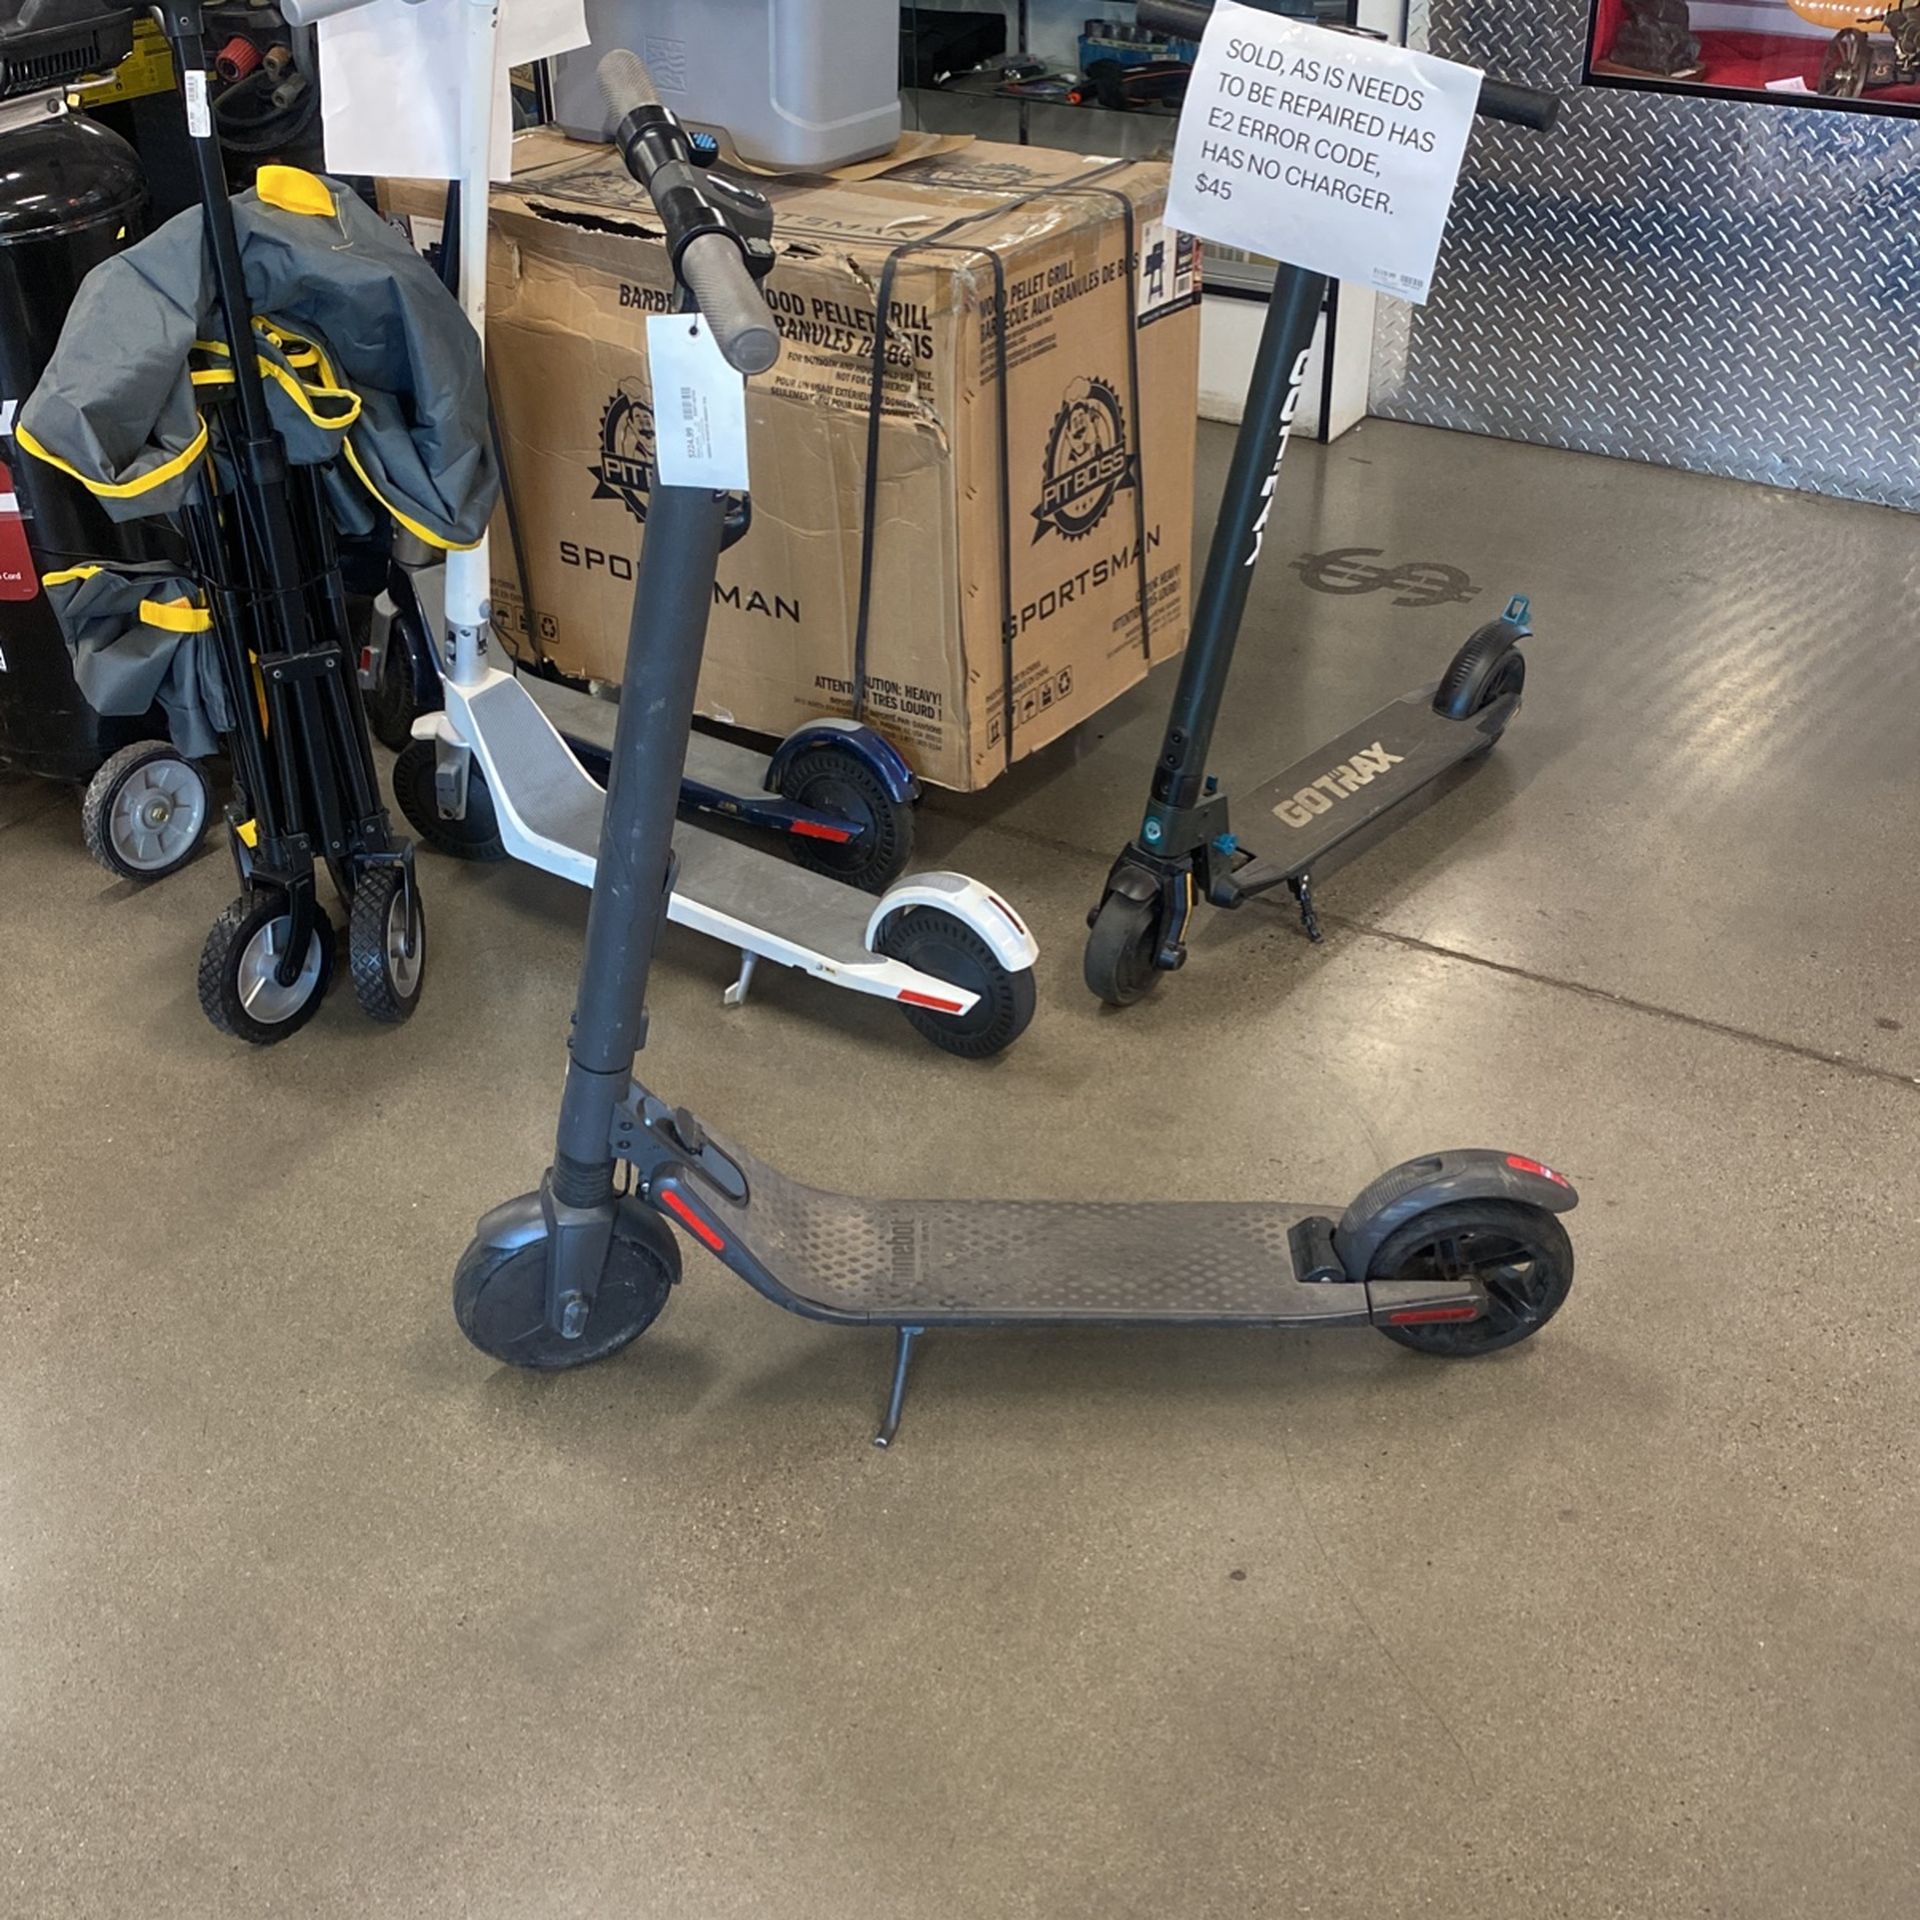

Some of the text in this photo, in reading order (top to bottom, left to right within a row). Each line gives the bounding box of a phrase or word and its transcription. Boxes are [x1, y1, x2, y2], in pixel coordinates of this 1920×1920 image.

[1226, 38, 1425, 111] SOLD, AS IS NEEDS
[1208, 107, 1381, 177] E2 ERROR CODE,
[1218, 73, 1436, 152] TO BE REPAIRED HAS
[1195, 172, 1233, 200] $45
[1201, 140, 1394, 215] HAS NO CHARGER.
[980, 301, 1029, 344] BARECUE
[1031, 292, 1051, 319] AUX
[1052, 269, 1099, 308] GRANULES
[1102, 261, 1115, 284] DE
[1010, 271, 1045, 305] PELLET
[1048, 259, 1074, 287] GRILL
[619, 283, 673, 314] BARBE
[773, 315, 855, 354] RANULES
[811, 297, 876, 333] PELLET
[890, 301, 933, 331] RILL
[604, 457, 643, 486] PIT
[1044, 451, 1125, 511] PIT BOSS
[900, 700, 936, 719] LOURD
[904, 685, 943, 706] HEAVY!
[1271, 741, 1405, 828] GOTRAX
[886, 1218, 915, 1283] ninebot
